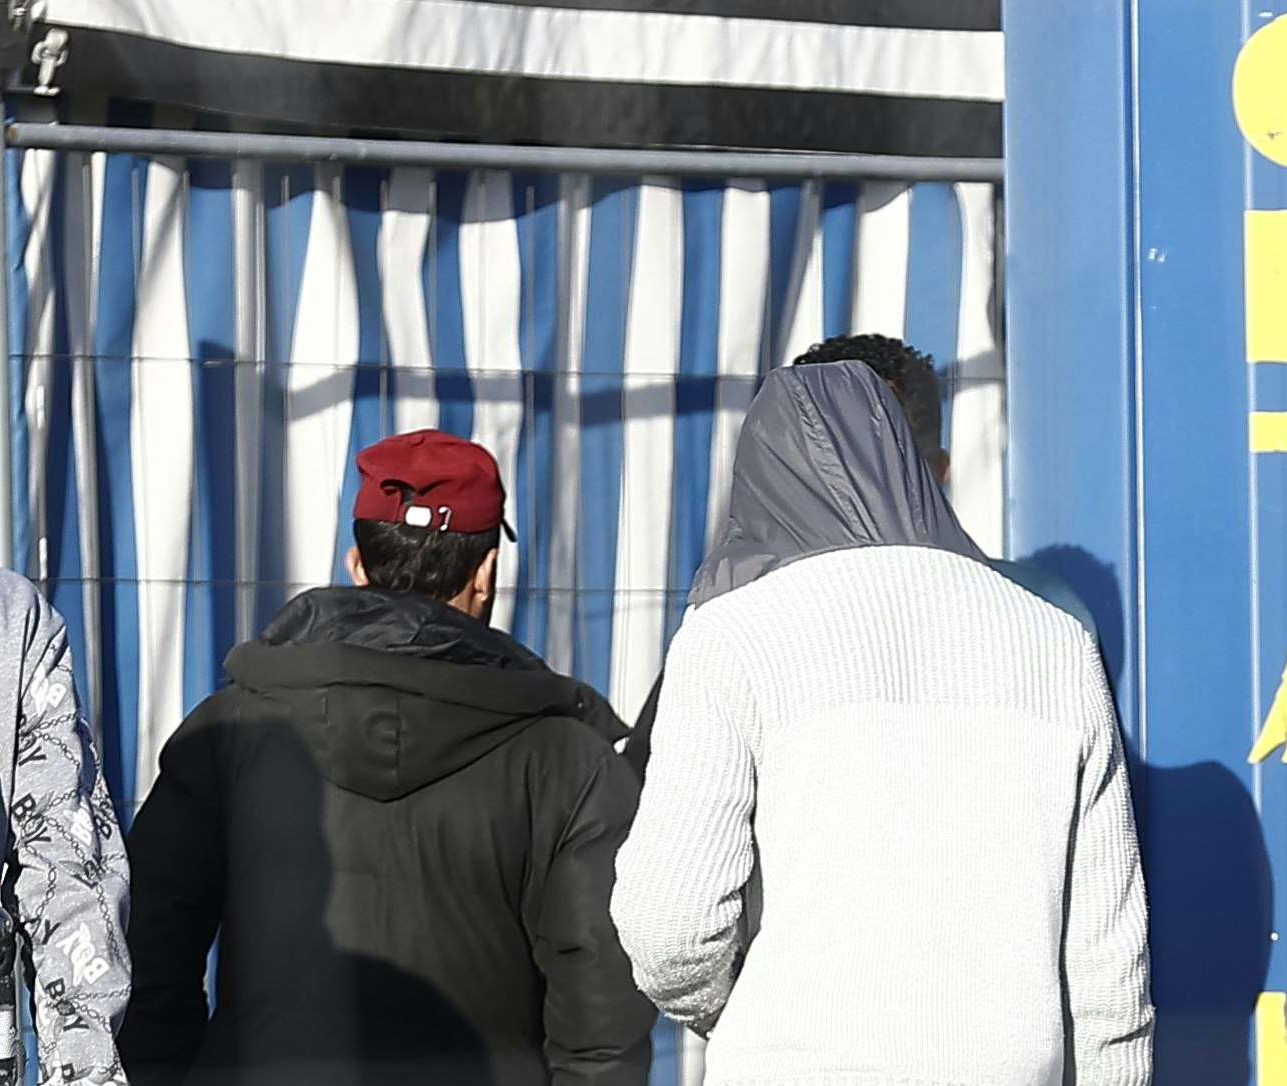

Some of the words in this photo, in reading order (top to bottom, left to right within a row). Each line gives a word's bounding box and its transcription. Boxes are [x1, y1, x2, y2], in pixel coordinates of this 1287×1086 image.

[12, 793, 52, 845] BOY
[56, 923, 110, 985] BOY
[44, 977, 90, 1032] BOY
